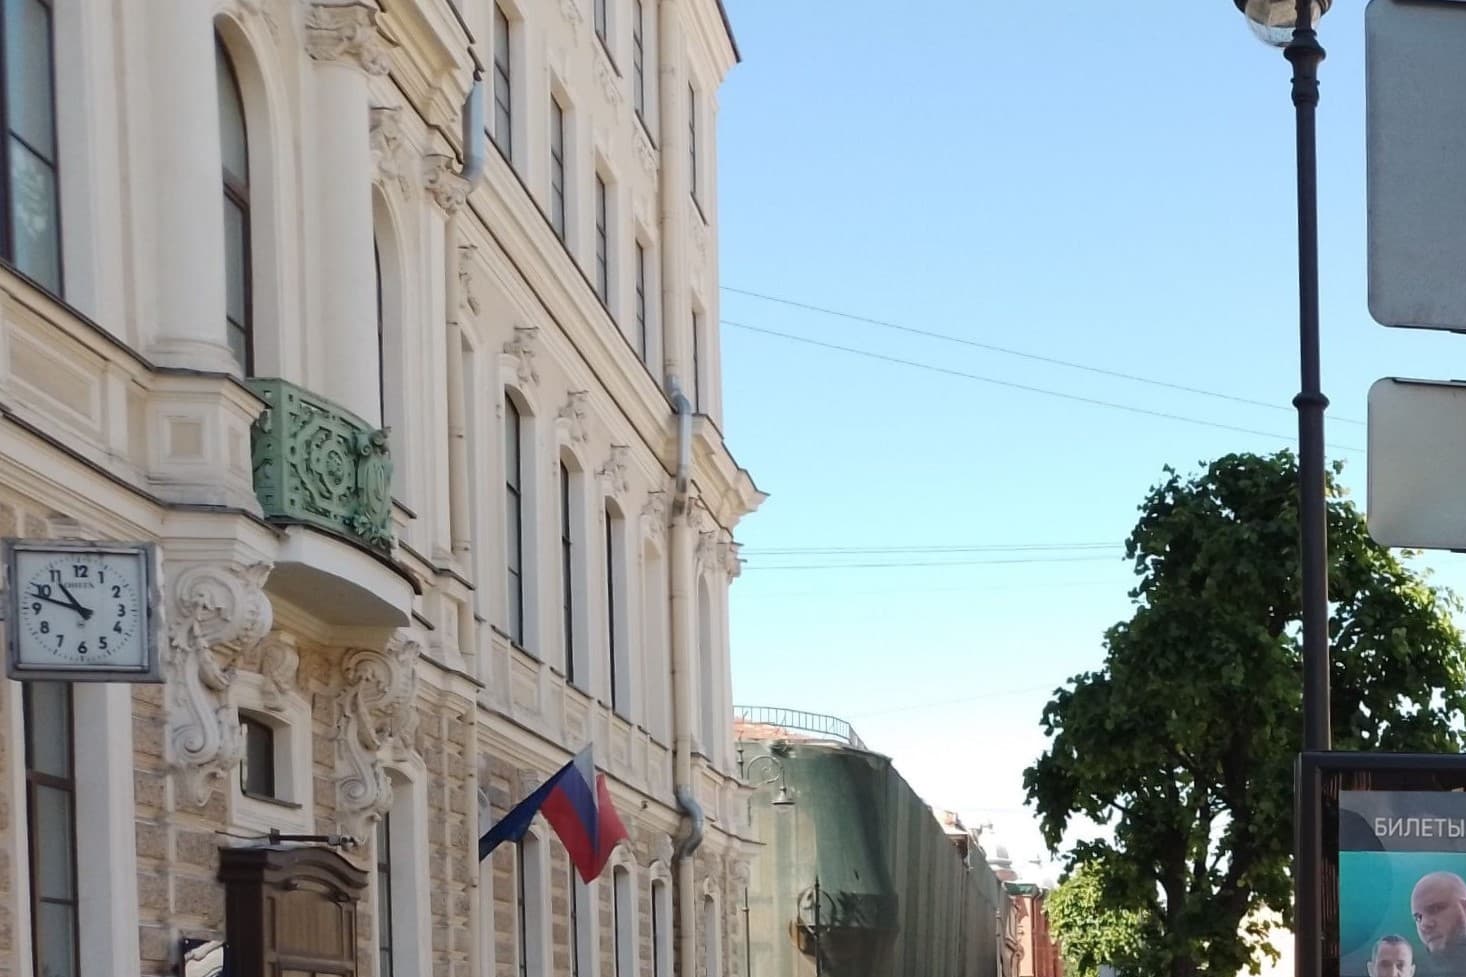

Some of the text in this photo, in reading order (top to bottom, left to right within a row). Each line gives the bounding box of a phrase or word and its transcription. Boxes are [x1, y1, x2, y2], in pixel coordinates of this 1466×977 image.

[50, 569, 61, 582] 11
[72, 565, 88, 578] 12
[37, 584, 51, 597] 10
[111, 585, 121, 598] 2
[32, 602, 42, 615] 9
[117, 604, 126, 617] 3
[40, 621, 49, 634] 8
[113, 621, 122, 634] 4
[56, 634, 64, 647] 7
[99, 636, 107, 649] 5
[77, 641, 88, 654] 6
[1374, 817, 1465, 839] БИЛЕТЫ
